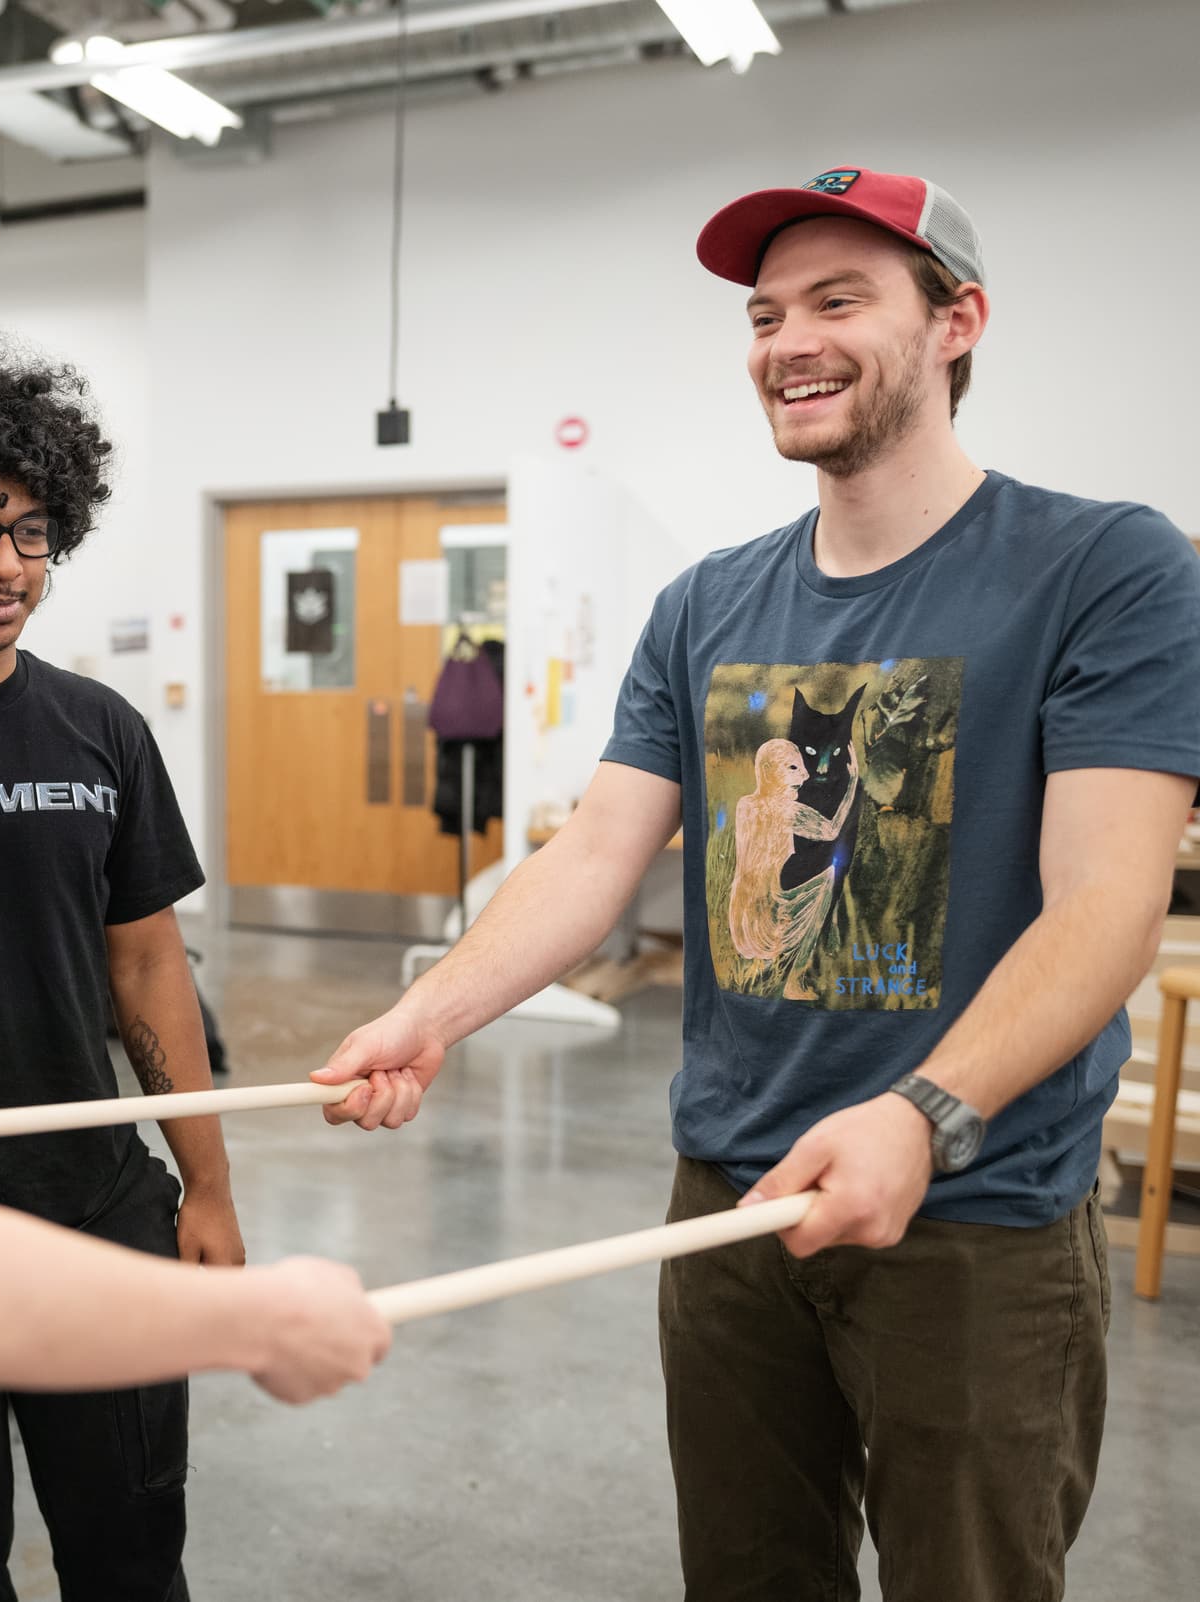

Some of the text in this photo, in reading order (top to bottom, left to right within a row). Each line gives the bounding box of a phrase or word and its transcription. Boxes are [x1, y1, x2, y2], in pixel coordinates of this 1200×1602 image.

[852, 943, 908, 962] LUCK
[888, 960, 917, 975] and
[835, 976, 927, 995] STRANGE
